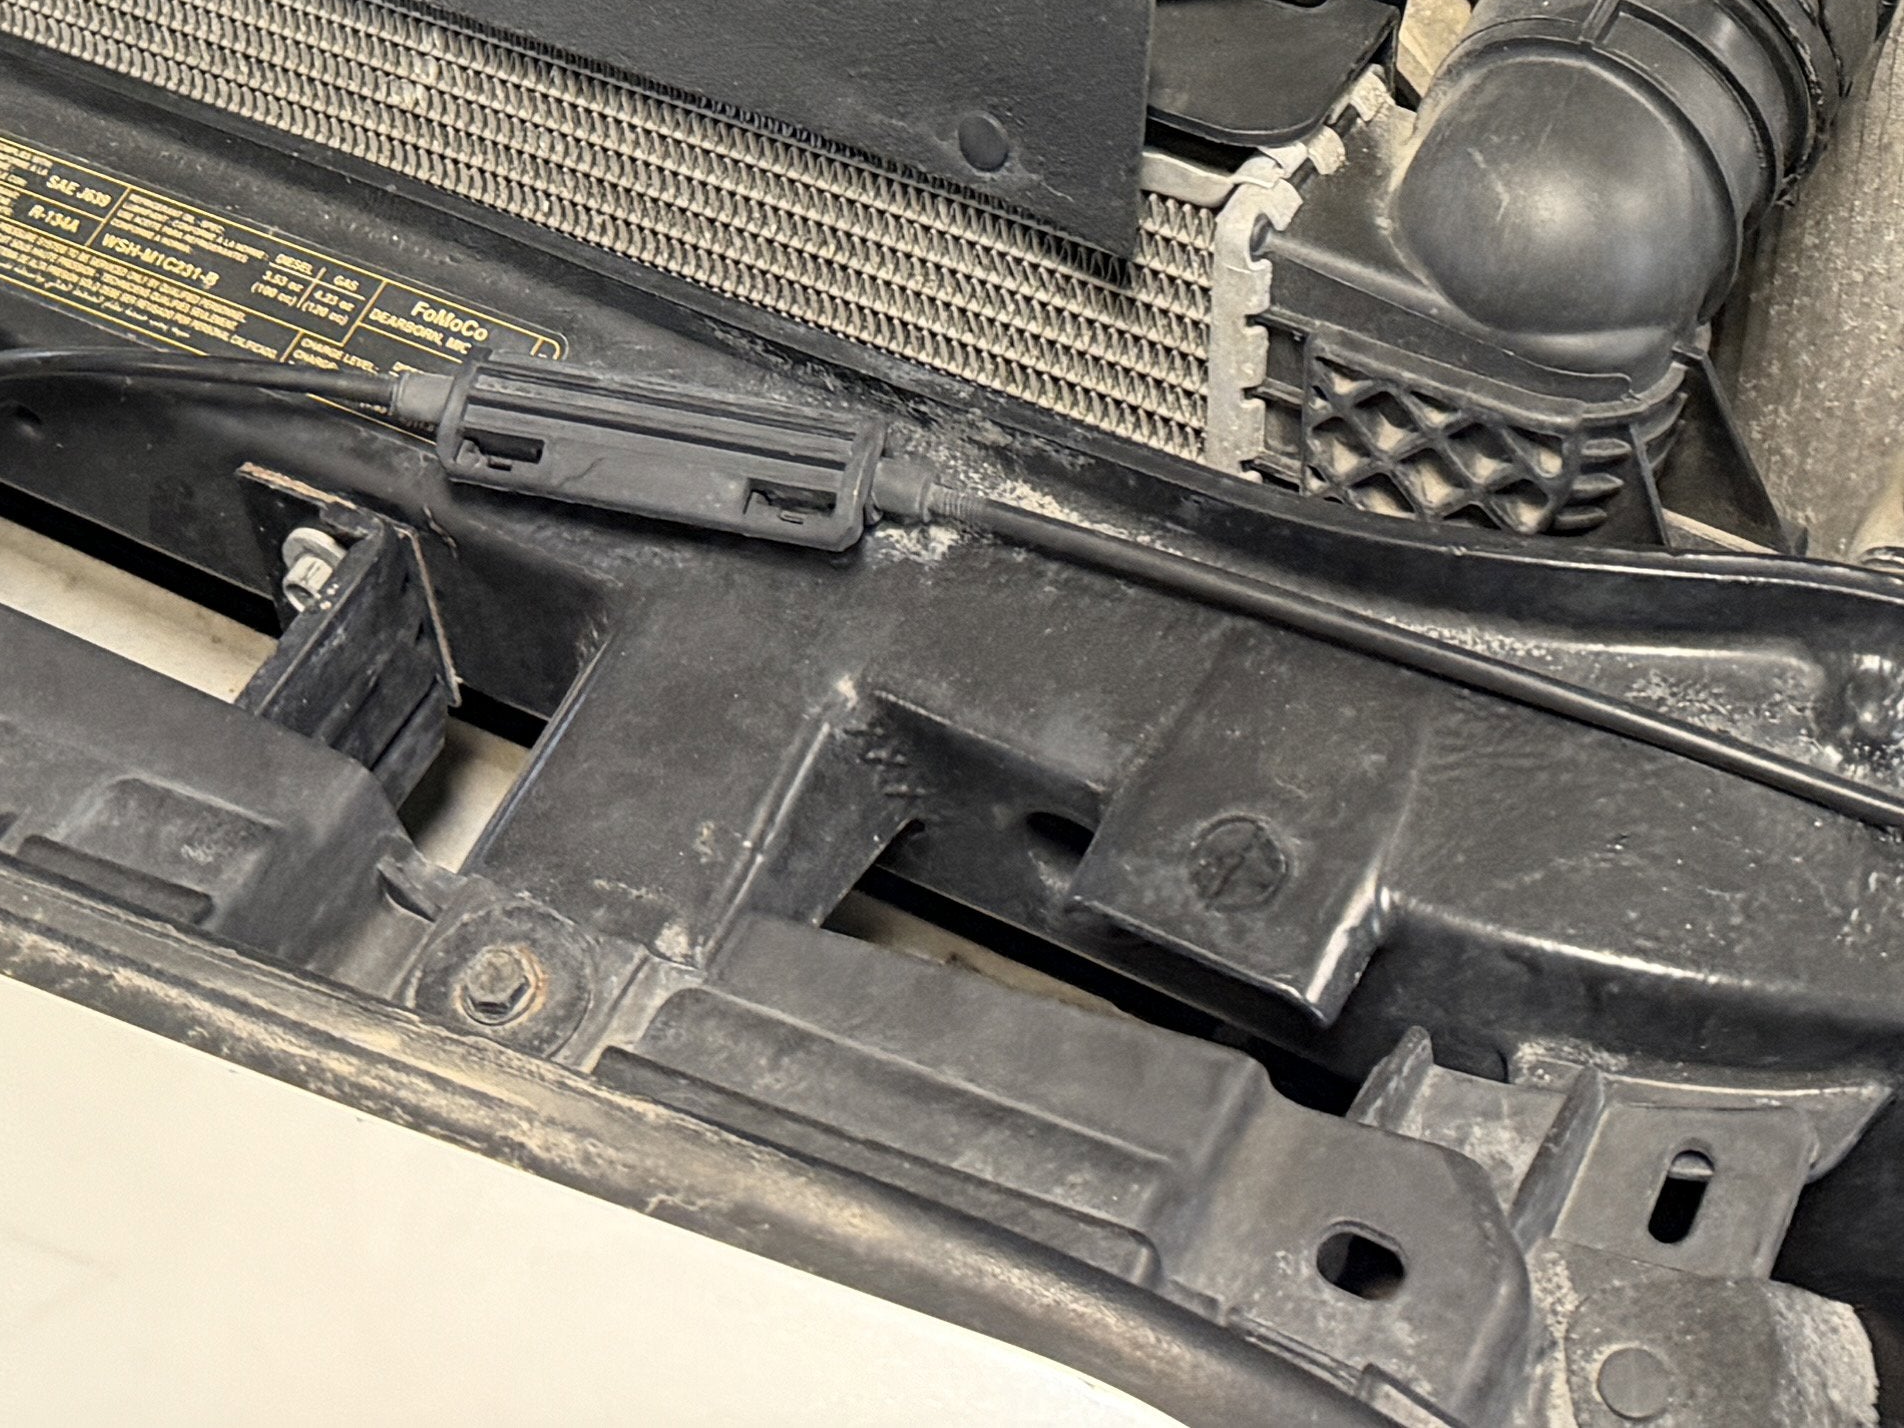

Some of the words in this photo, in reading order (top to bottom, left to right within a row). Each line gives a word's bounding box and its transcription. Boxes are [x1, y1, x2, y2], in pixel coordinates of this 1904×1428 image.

[46, 174, 79, 199] SAE
[27, 204, 82, 234] R-134A
[273, 252, 315, 276] DIESEL
[332, 274, 360, 293] GAS
[368, 307, 445, 347] DEARBORN,
[410, 300, 490, 343] FoMoCo
